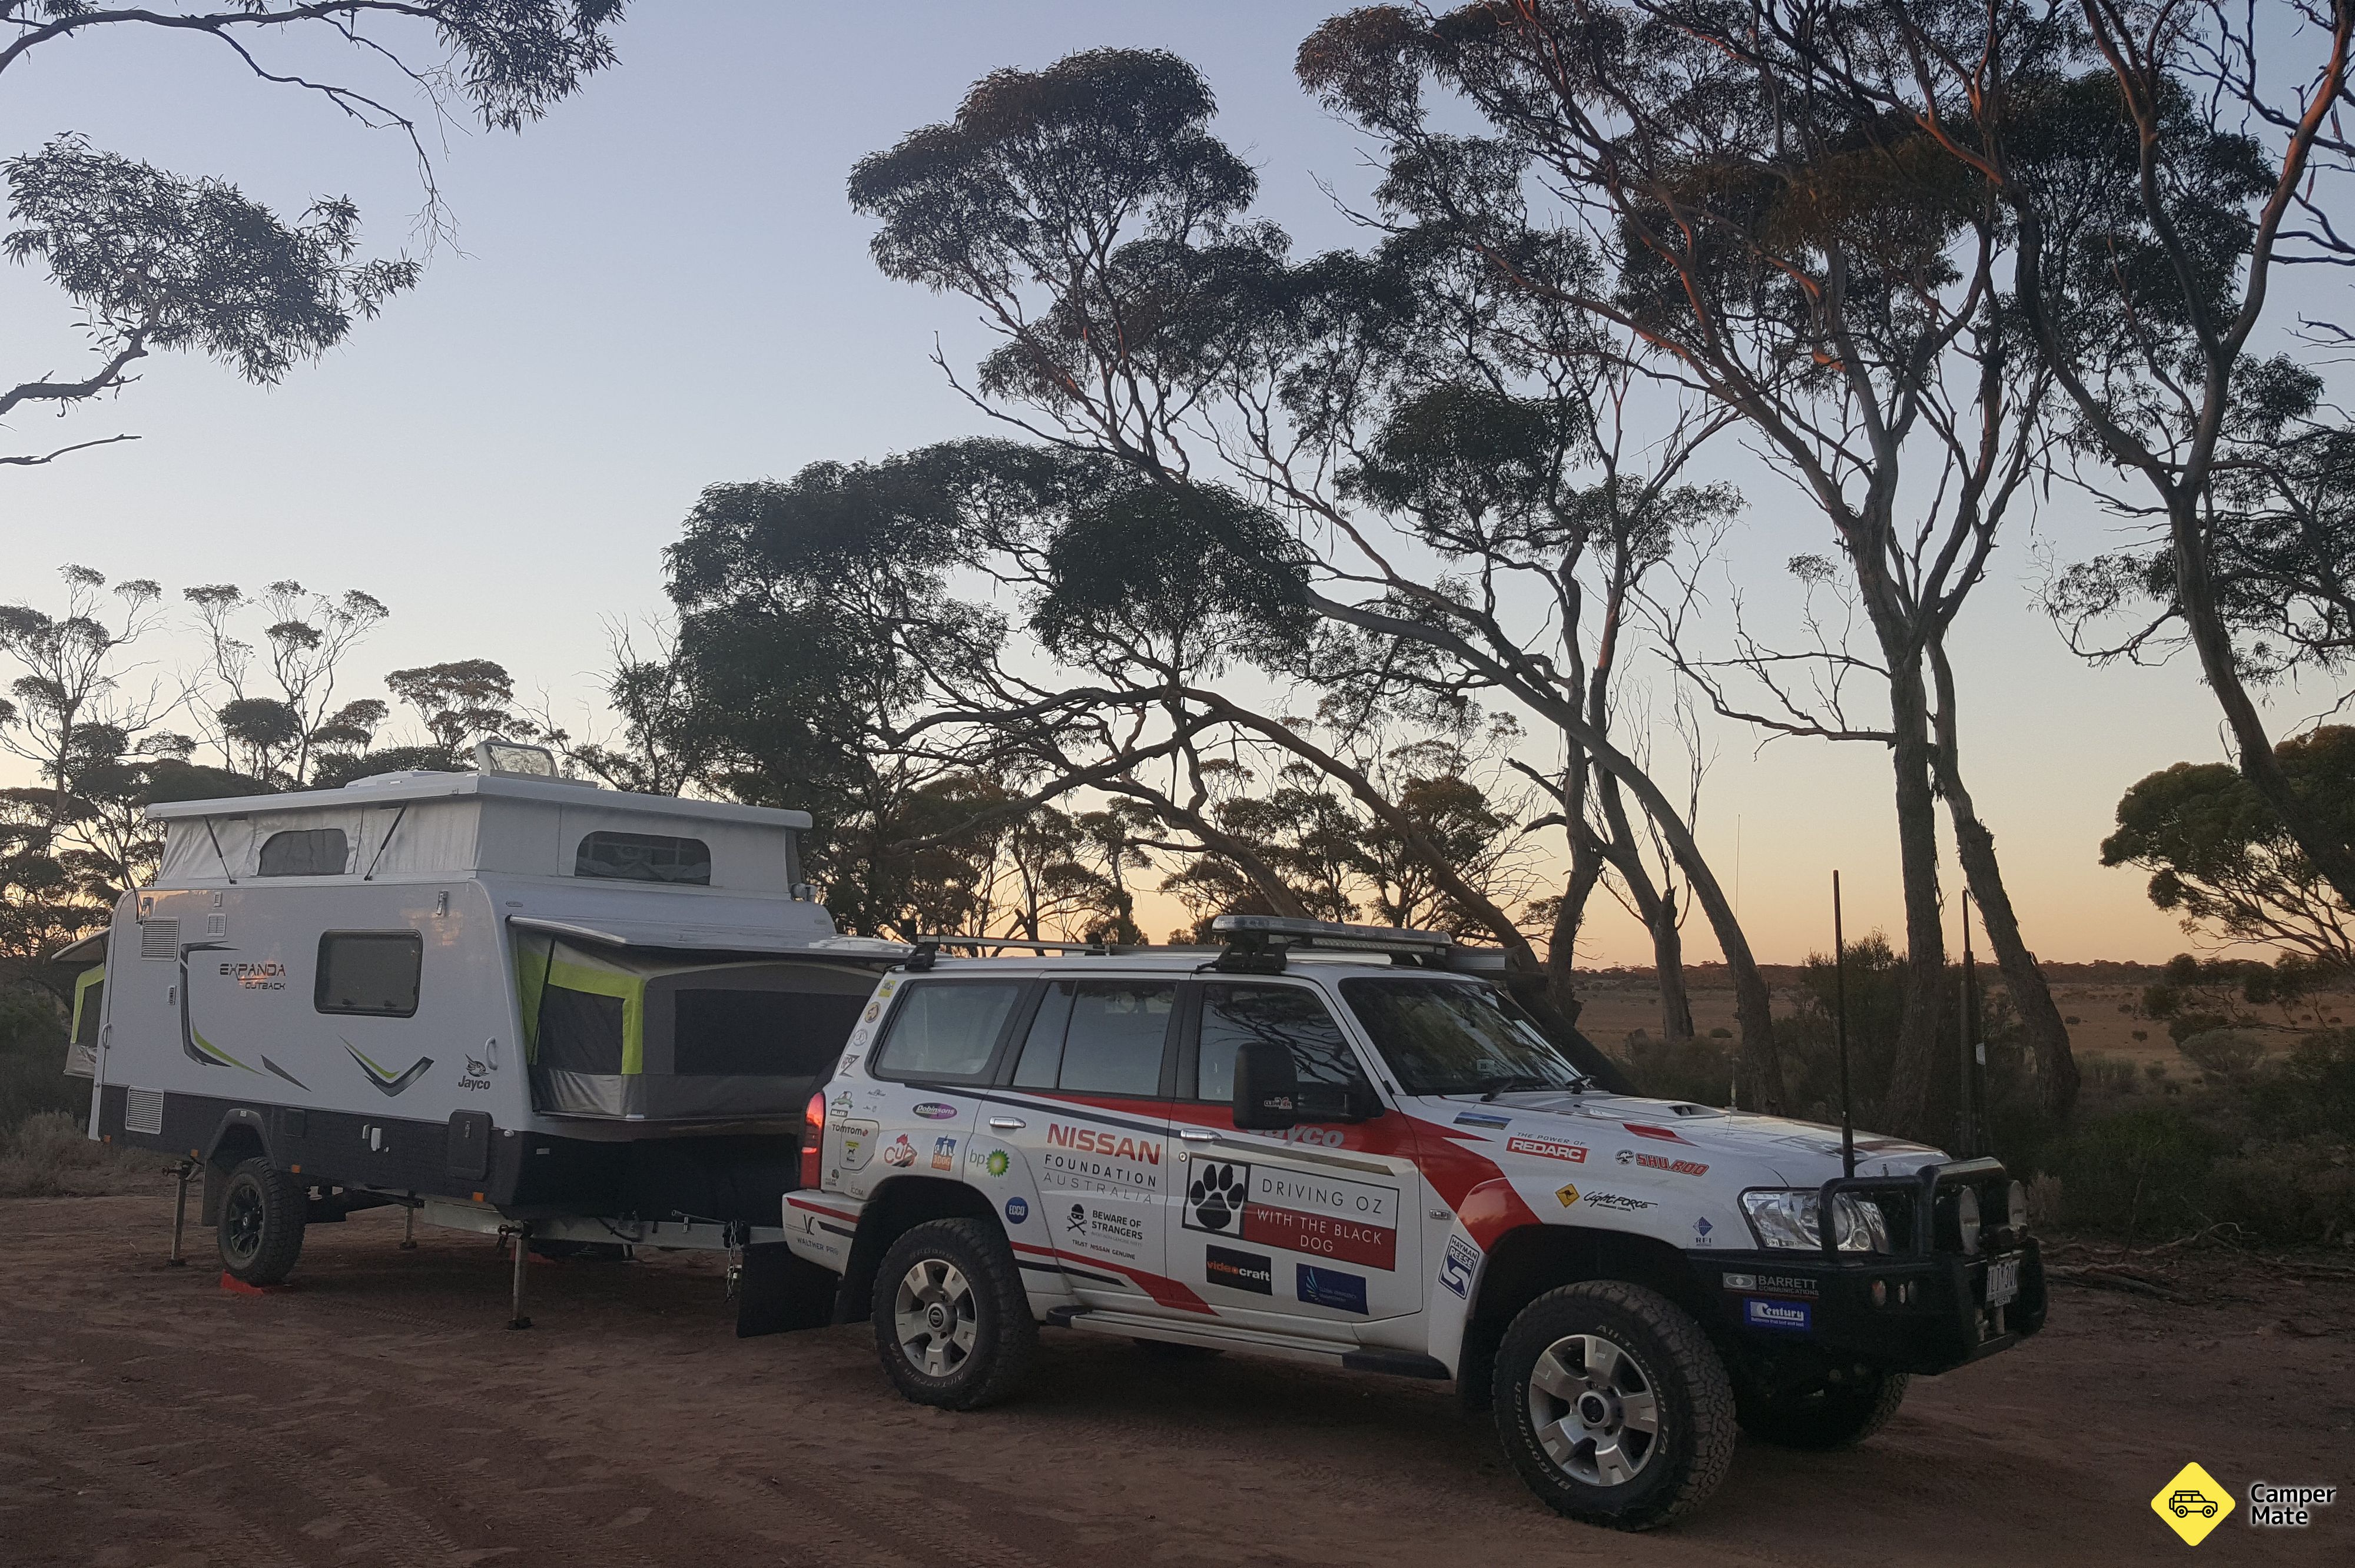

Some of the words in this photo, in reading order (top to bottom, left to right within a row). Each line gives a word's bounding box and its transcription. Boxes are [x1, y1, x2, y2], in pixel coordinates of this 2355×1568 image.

[220, 963, 286, 977] EXPANDA
[458, 1075, 490, 1091] Jayco
[916, 1105, 954, 1115] Dobinsons
[1047, 1123, 1161, 1165] NISSAN
[1537, 1135, 1570, 1144] POWER
[969, 1149, 985, 1167] bp
[1511, 1140, 1582, 1160] REDARC
[1045, 1154, 1156, 1187] FOUNDATION
[1043, 1172, 1152, 1204] AUSTRALIA
[1262, 1178, 1344, 1206] DRIVING
[1356, 1195, 1382, 1214] OZ
[1092, 1210, 1127, 1225] BEWARE
[1129, 1219, 1142, 1228] OF
[1257, 1208, 1292, 1227] WITH
[1300, 1217, 1326, 1233] THE
[1334, 1224, 1382, 1245] BLACK
[1092, 1221, 1143, 1240] STRANGERS
[1072, 1239, 1088, 1248] TRUST
[1090, 1244, 1110, 1254] NISSAN
[1112, 1249, 1136, 1260] GENUINE
[1300, 1235, 1334, 1253] DOG
[1452, 1238, 1478, 1260] HAYMAN
[1449, 1247, 1474, 1270] REESE
[1758, 1275, 1817, 1290] BARRETT
[1759, 1285, 1819, 1295] COMMUNICATIONS
[1756, 1302, 1805, 1320] Century
